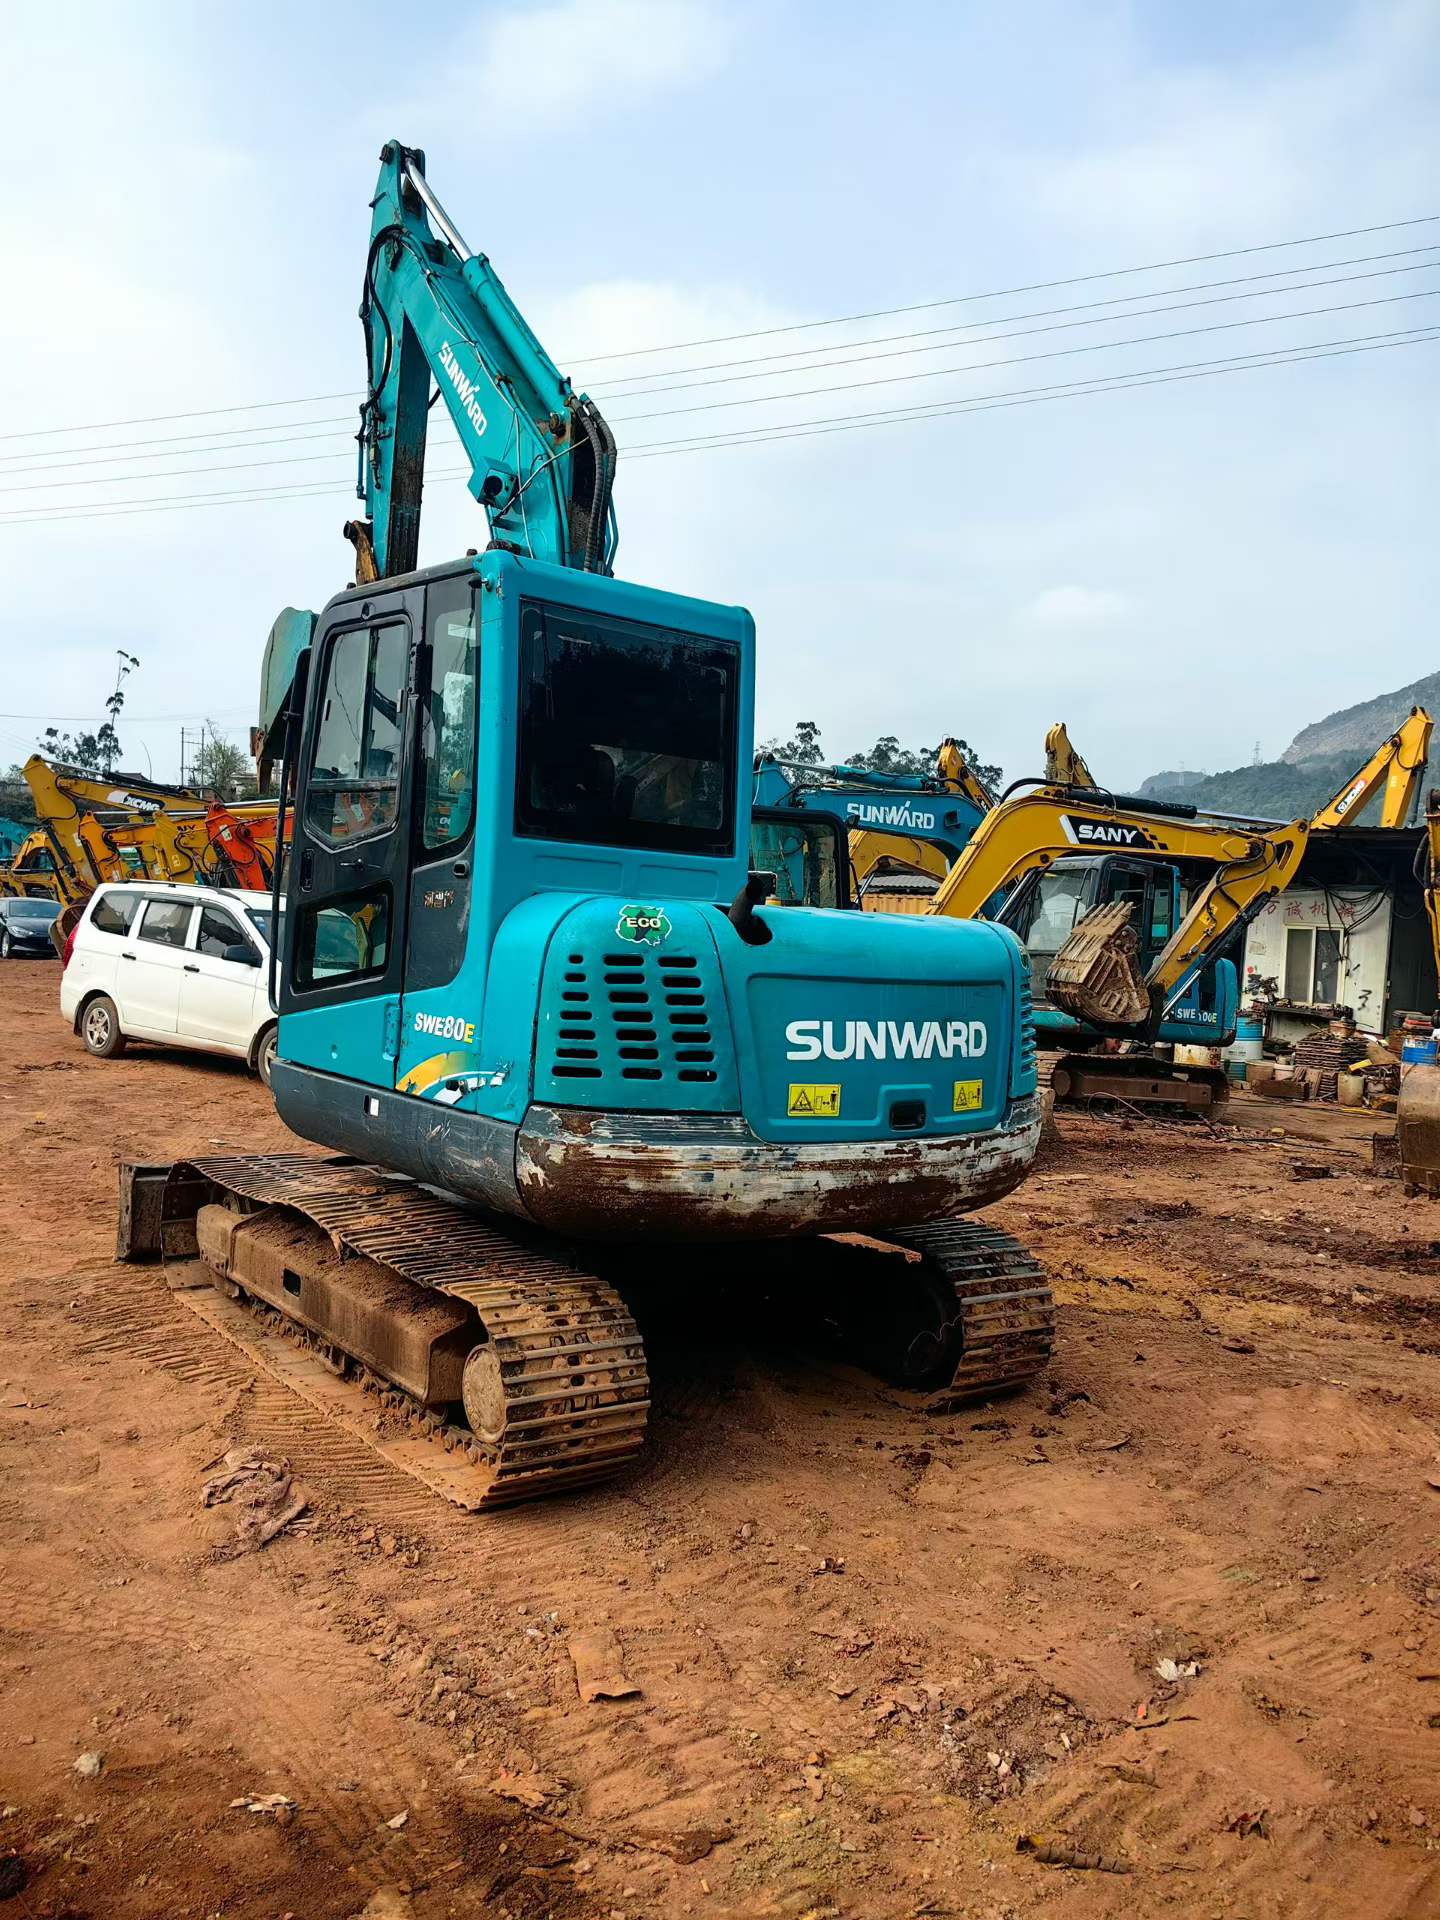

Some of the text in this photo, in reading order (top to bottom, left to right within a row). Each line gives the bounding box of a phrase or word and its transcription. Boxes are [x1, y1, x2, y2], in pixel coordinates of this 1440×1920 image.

[438, 341, 488, 436] SUNWARD
[125, 795, 161, 811] XCMG
[847, 800, 935, 830] SUNWARD
[1078, 824, 1138, 844] SANY
[626, 917, 661, 928] ECO
[414, 1012, 475, 1044] SWE80E
[785, 1020, 988, 1061] SUNWARD
